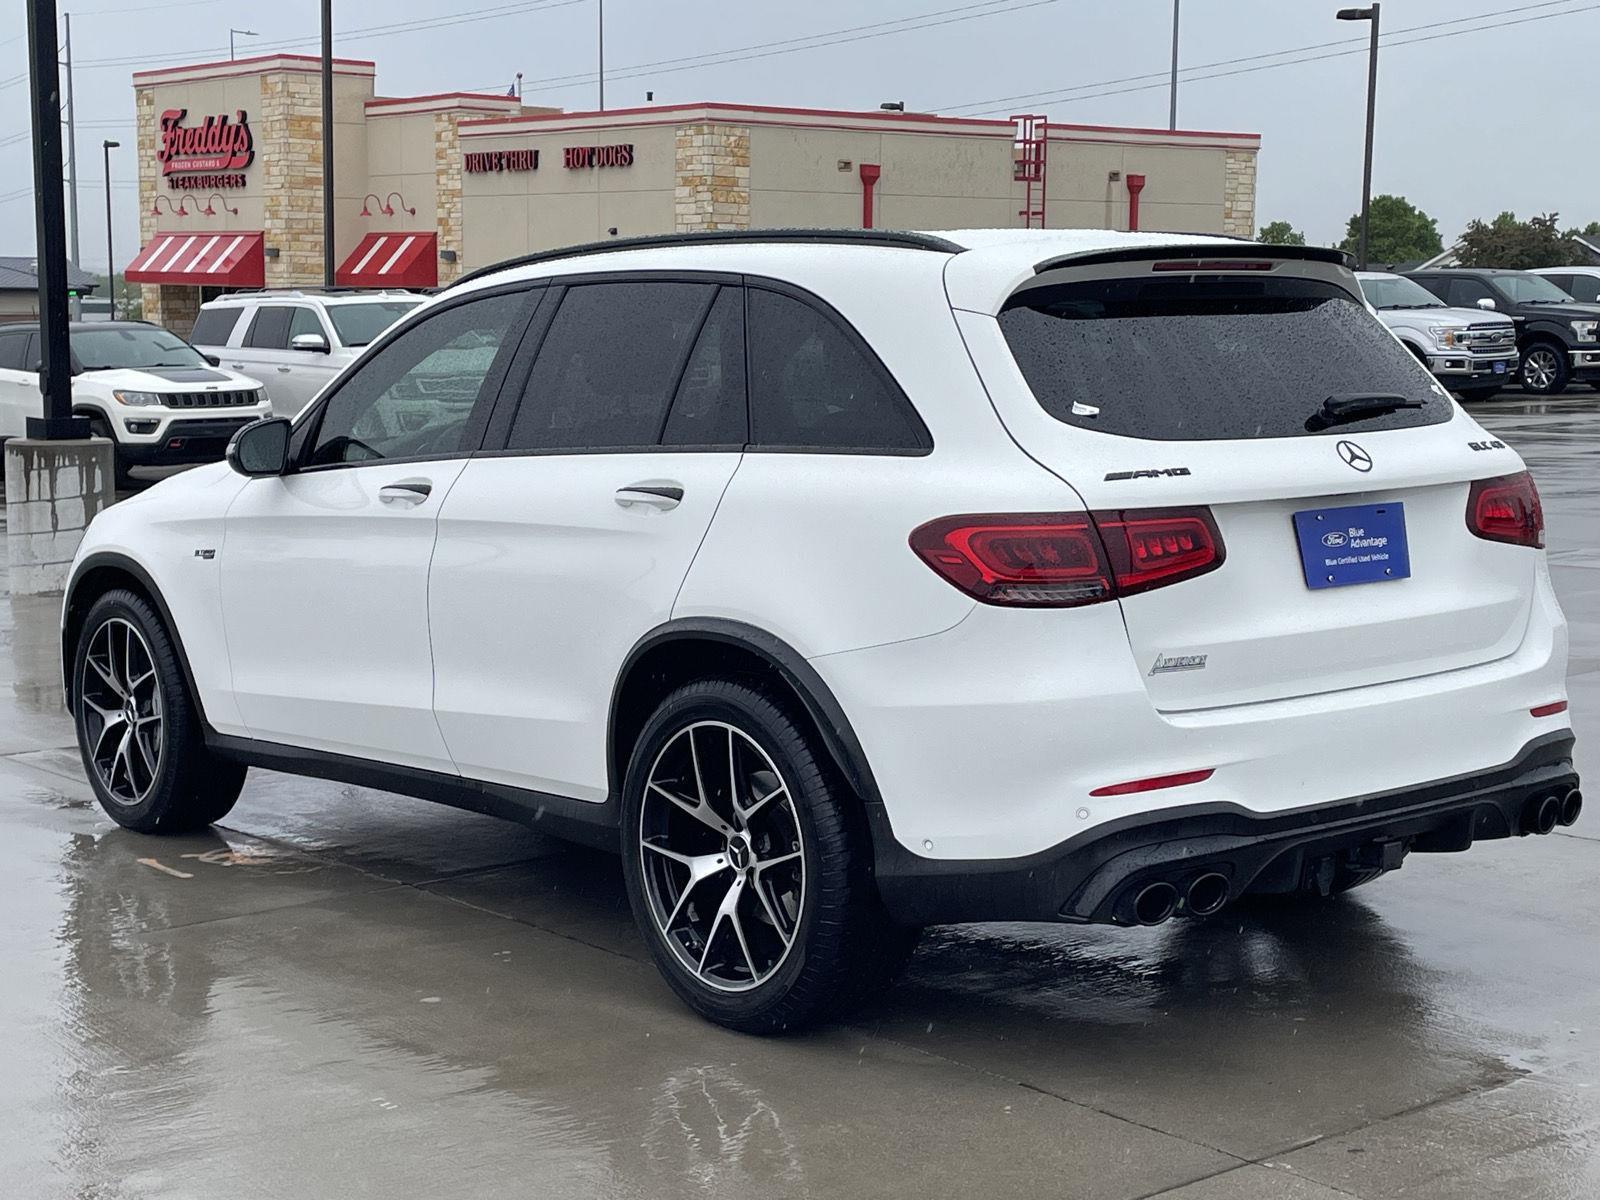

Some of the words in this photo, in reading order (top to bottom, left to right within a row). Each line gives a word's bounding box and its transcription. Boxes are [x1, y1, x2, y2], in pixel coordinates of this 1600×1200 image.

[157, 109, 254, 163] Freddy's
[503, 150, 539, 170] THRU
[562, 147, 593, 168] HOT
[595, 144, 633, 168] DOGS
[1348, 527, 1365, 538] Blue
[1350, 537, 1387, 548] Advantage
[1337, 555, 1358, 565] Certified
[1370, 552, 1389, 561] Vehicle
